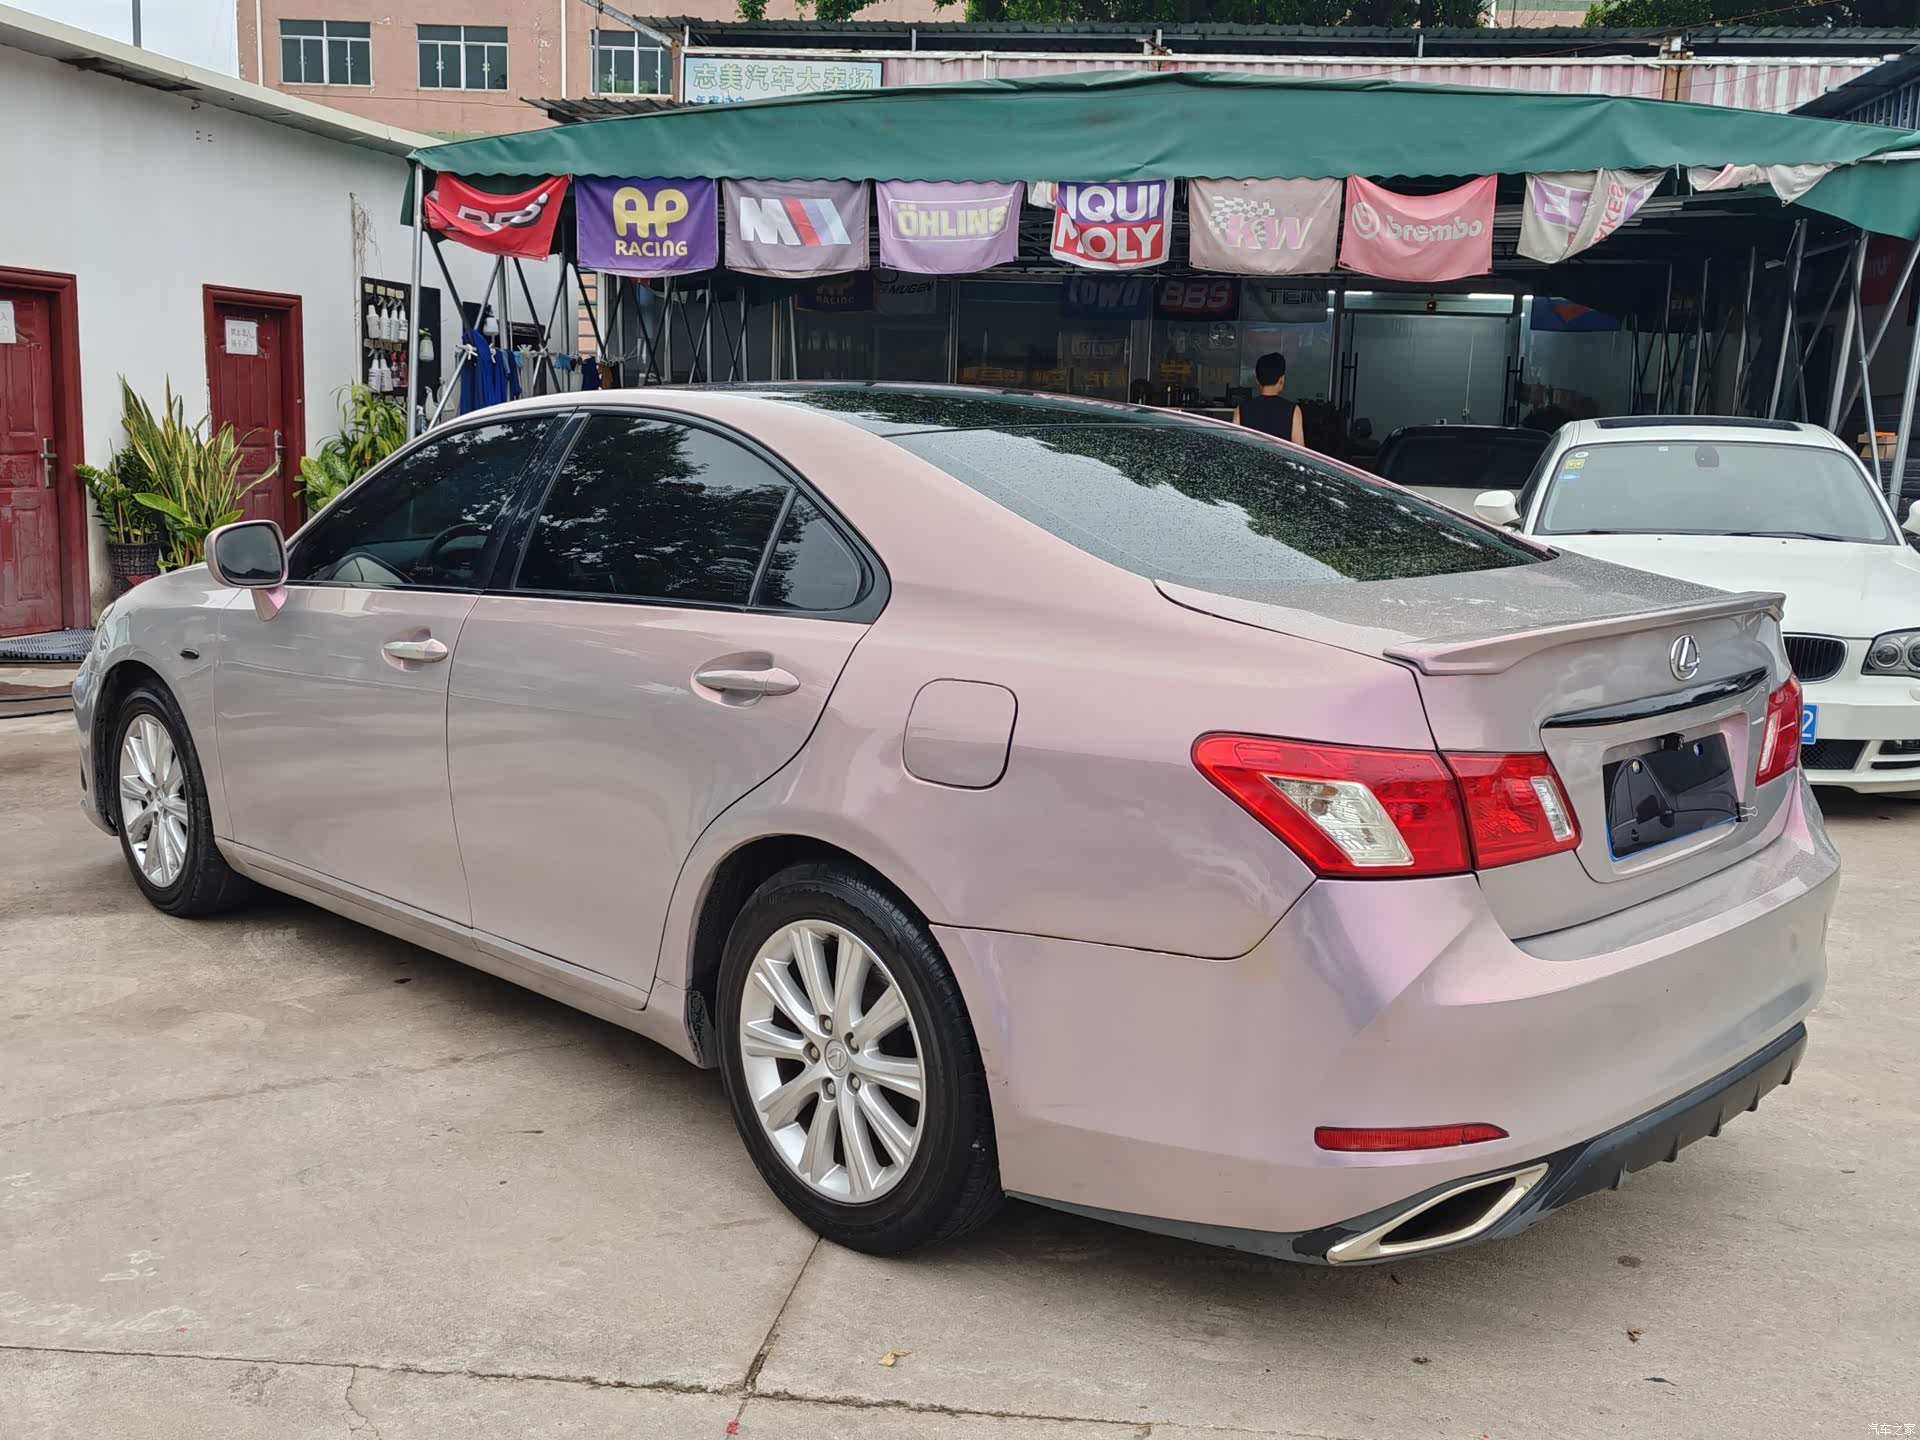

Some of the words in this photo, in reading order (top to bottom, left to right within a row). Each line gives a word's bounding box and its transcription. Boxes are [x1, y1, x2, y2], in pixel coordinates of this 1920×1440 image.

[693, 63, 873, 91] 志美汽车大卖场
[612, 186, 689, 238] AP
[897, 203, 1008, 238] ÖHLINS
[1056, 212, 1161, 261] MOLY
[1385, 215, 1483, 241] brembo
[615, 240, 688, 257] RACING
[888, 281, 934, 295] MUGEN
[1160, 280, 1232, 309] BBS
[1265, 288, 1325, 305] TEIN
